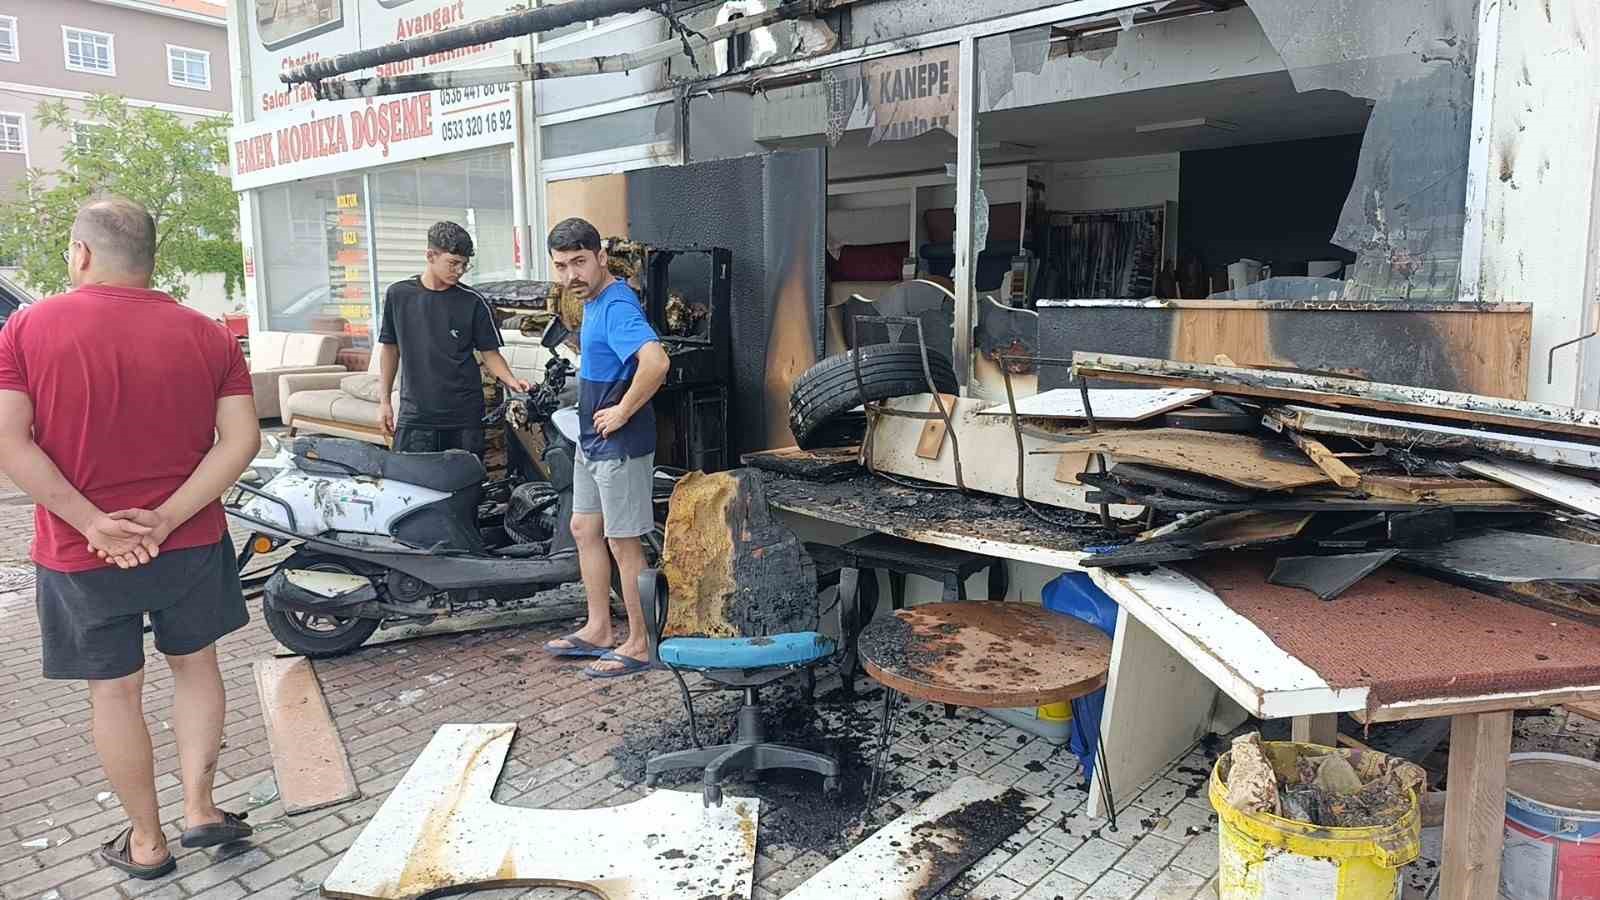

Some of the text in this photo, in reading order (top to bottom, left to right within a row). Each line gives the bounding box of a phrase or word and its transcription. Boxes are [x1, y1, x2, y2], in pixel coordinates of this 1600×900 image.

[397, 0, 464, 40] Avangart
[440, 88, 461, 106] 0536
[880, 60, 949, 104] KANEPE
[263, 90, 289, 111] Salon
[235, 93, 433, 175] EMEK MOBİLYA DÖŞEME
[442, 109, 512, 141] 0533 320 16 92
